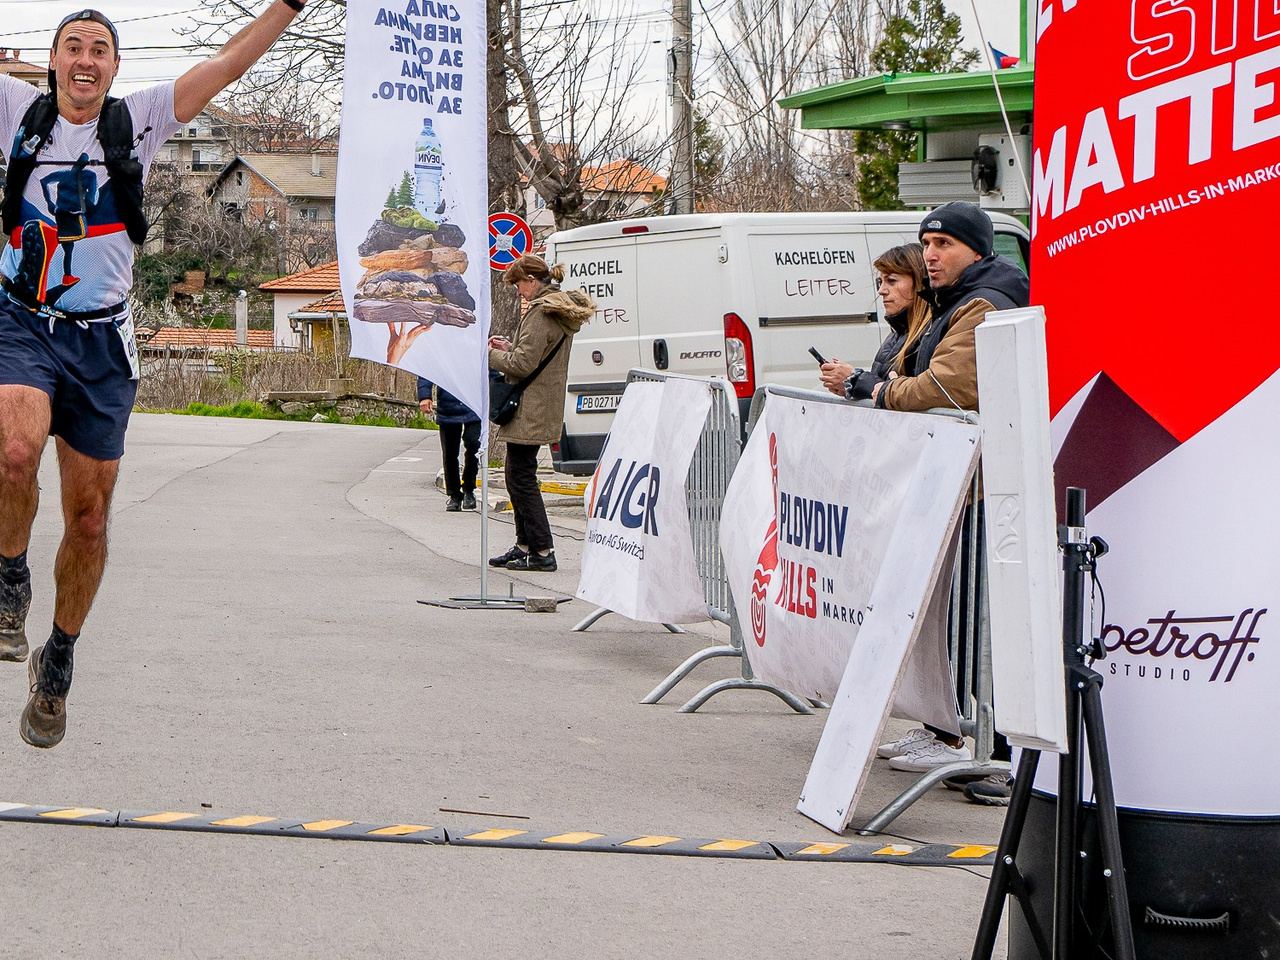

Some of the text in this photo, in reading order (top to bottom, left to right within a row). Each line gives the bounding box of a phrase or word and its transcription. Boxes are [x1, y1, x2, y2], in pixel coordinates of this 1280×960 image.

[1031, 47, 1280, 241] MATTE
[774, 248, 856, 266] KACHELÖFEN
[570, 260, 623, 277] KACHEL
[785, 278, 856, 297] LEITER
[593, 308, 629, 324] TER
[679, 350, 722, 360] DUCATO
[582, 397, 593, 408] PB
[595, 396, 614, 408] 0271
[780, 491, 849, 558] PLOVDIV
[822, 576, 834, 595] IN
[822, 601, 864, 627] MARKO
[1110, 662, 1191, 682] STUDIO
